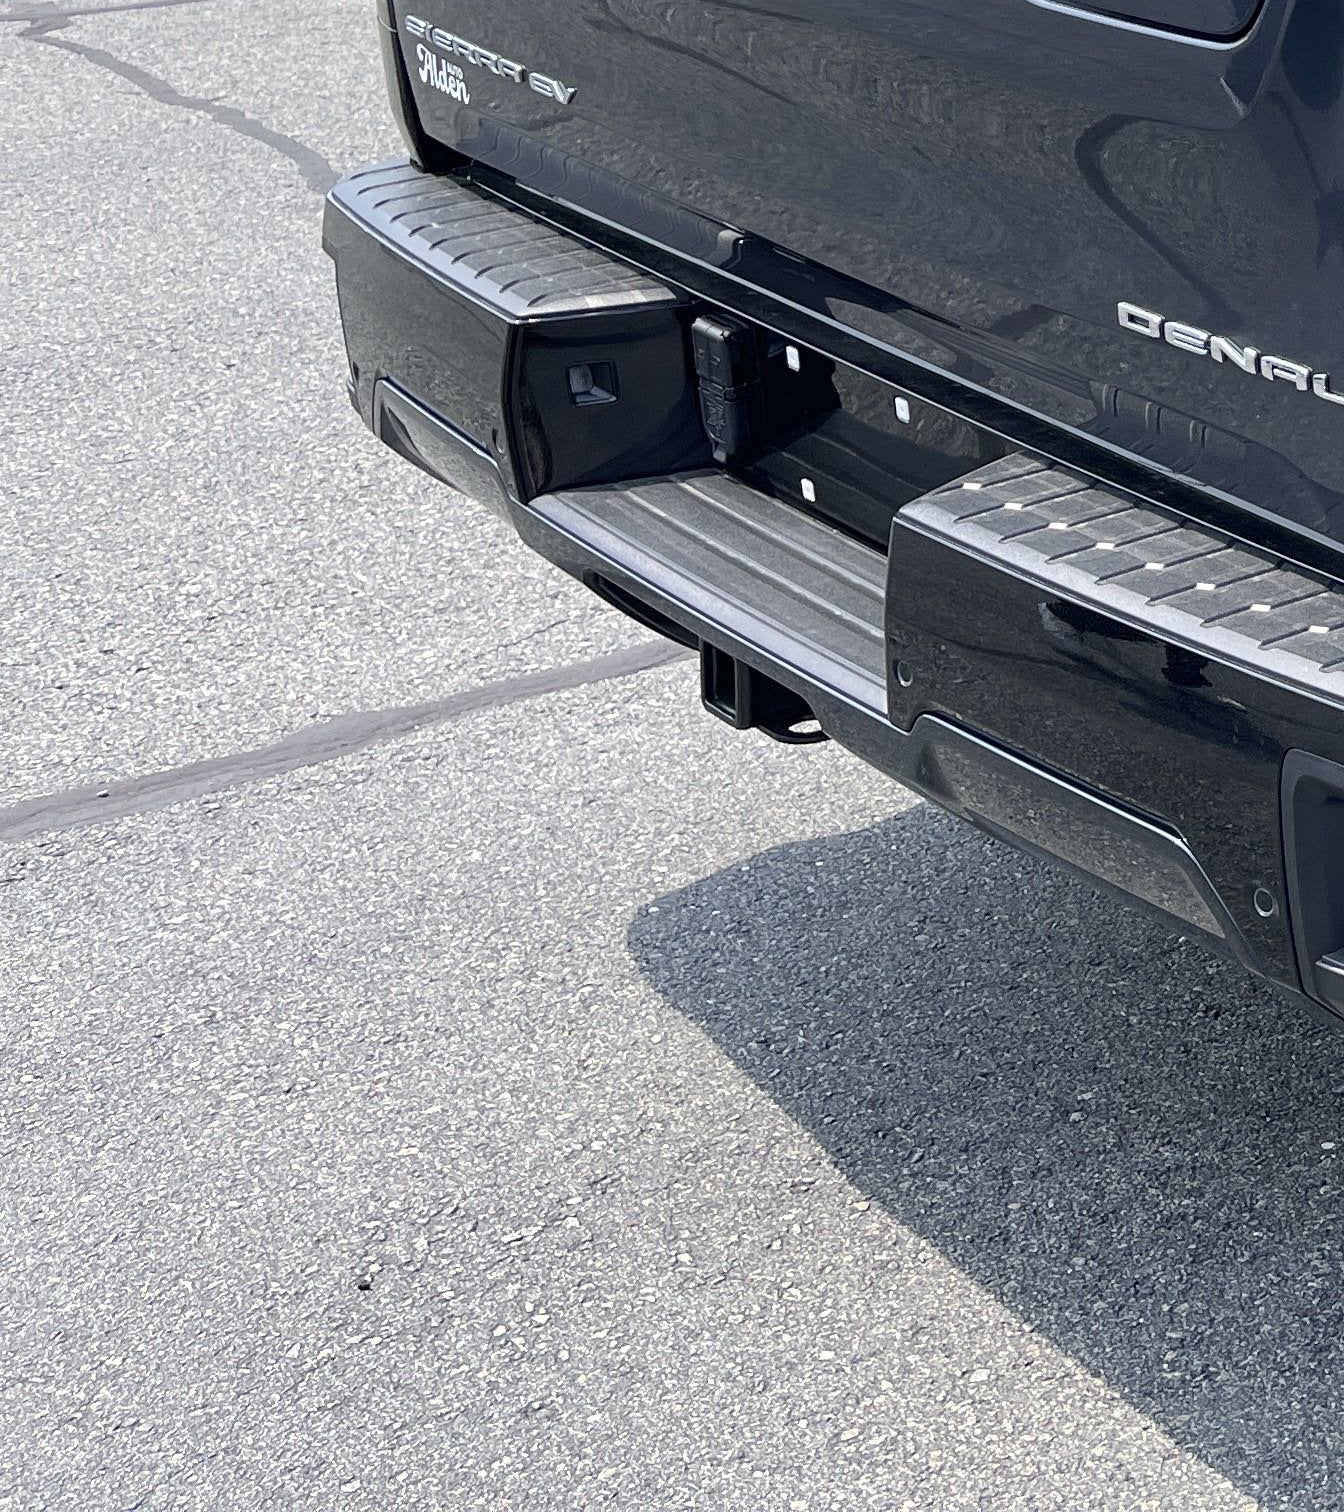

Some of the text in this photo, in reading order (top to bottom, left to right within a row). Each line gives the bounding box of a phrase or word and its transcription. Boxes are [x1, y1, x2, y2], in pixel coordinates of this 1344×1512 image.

[405, 14, 577, 105] SIERRA EV
[416, 43, 470, 105] Alden
